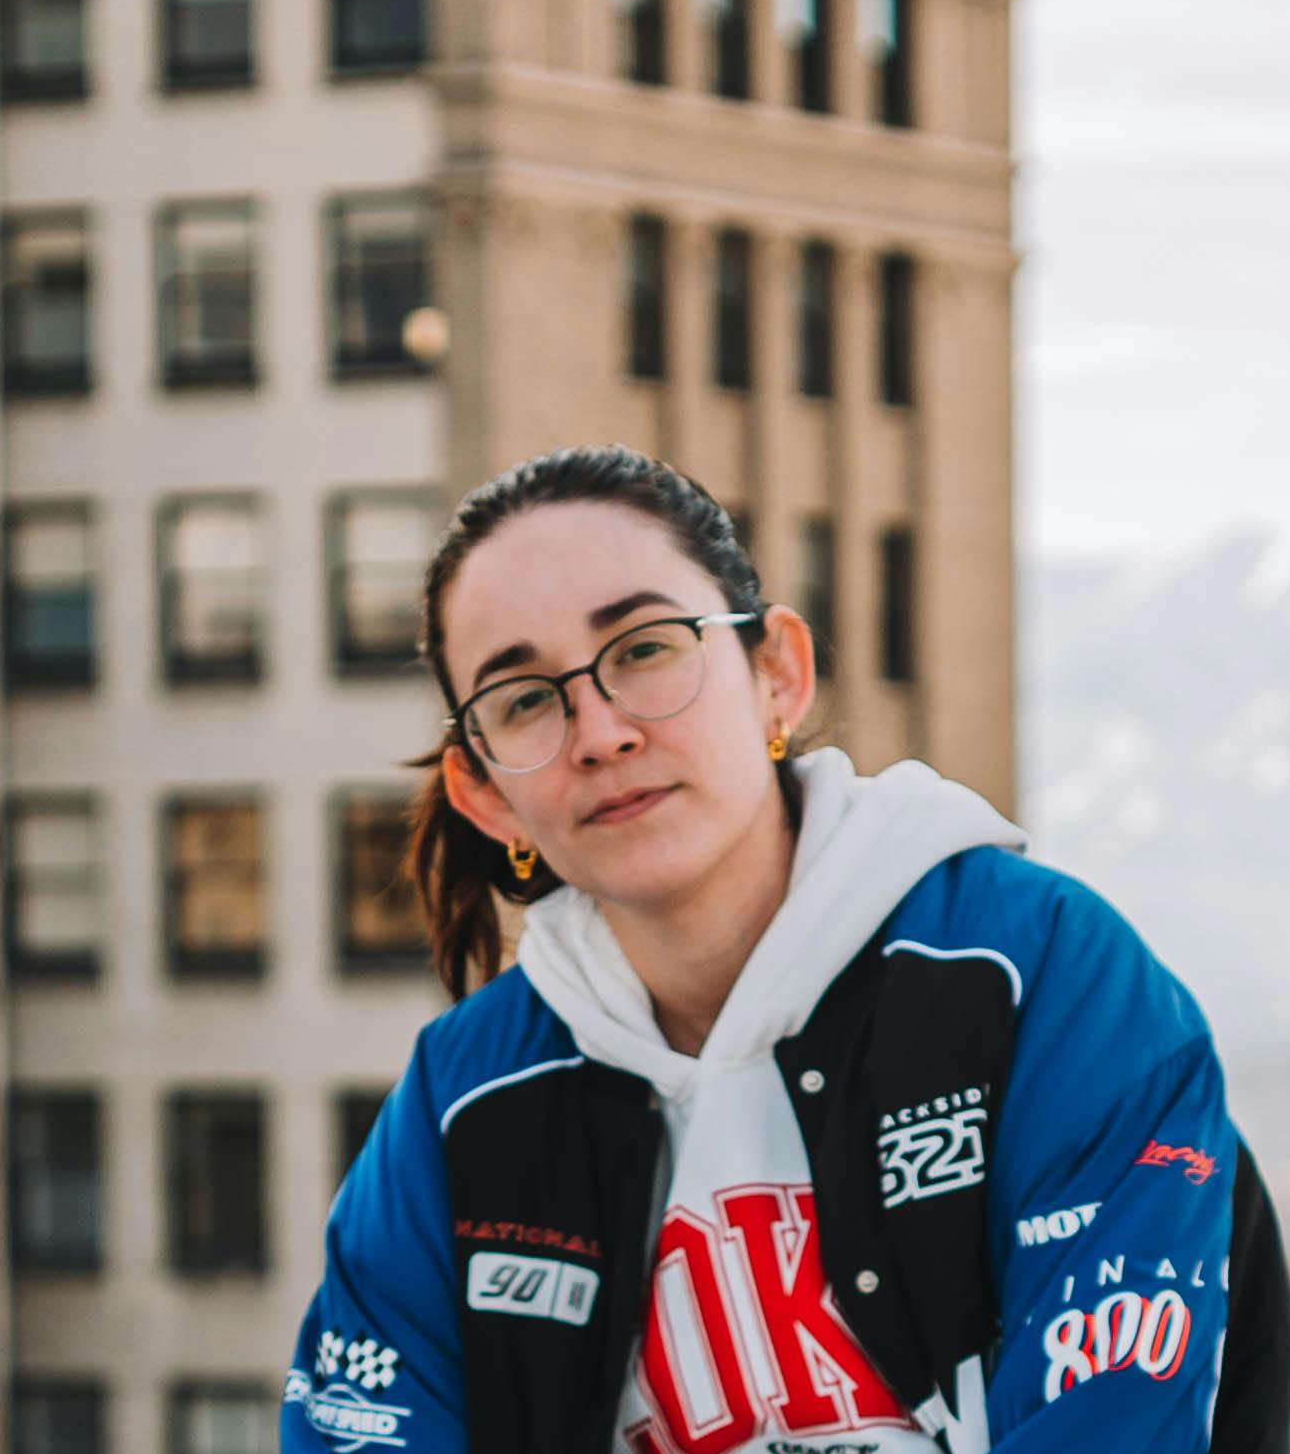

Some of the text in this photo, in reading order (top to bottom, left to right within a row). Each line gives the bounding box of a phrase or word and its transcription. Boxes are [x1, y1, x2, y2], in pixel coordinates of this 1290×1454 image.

[879, 1083, 990, 1130] ACKSID
[454, 1218, 602, 1257] NATIONAL
[479, 1263, 548, 1304] 90
[1043, 1288, 1192, 1404] 800
